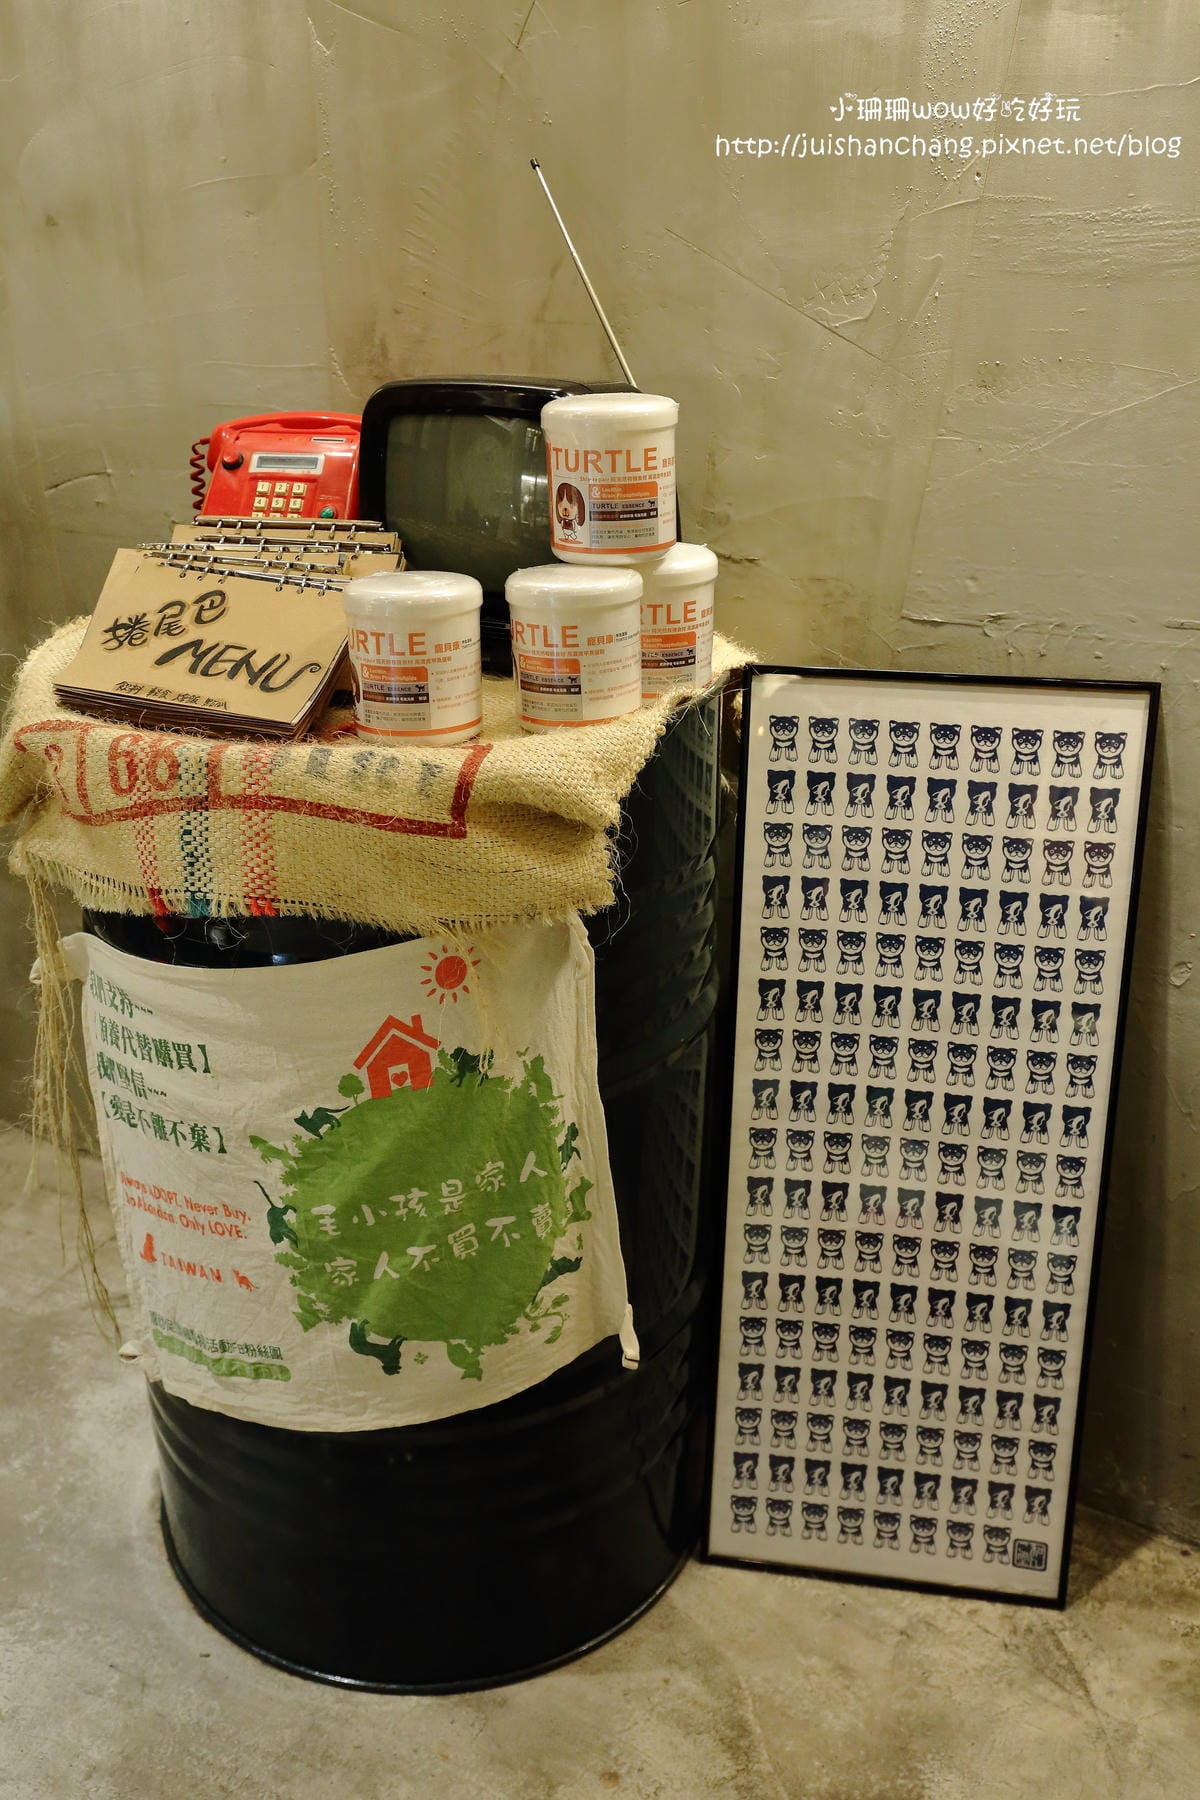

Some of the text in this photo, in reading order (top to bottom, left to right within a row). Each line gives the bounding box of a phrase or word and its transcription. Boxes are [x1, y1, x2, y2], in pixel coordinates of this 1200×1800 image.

[553, 447, 658, 473] TURTLE
[154, 638, 321, 693] MENU
[184, 1196, 219, 1216] Never
[179, 1212, 205, 1236] Only
[161, 1251, 224, 1283] TAIWAN
